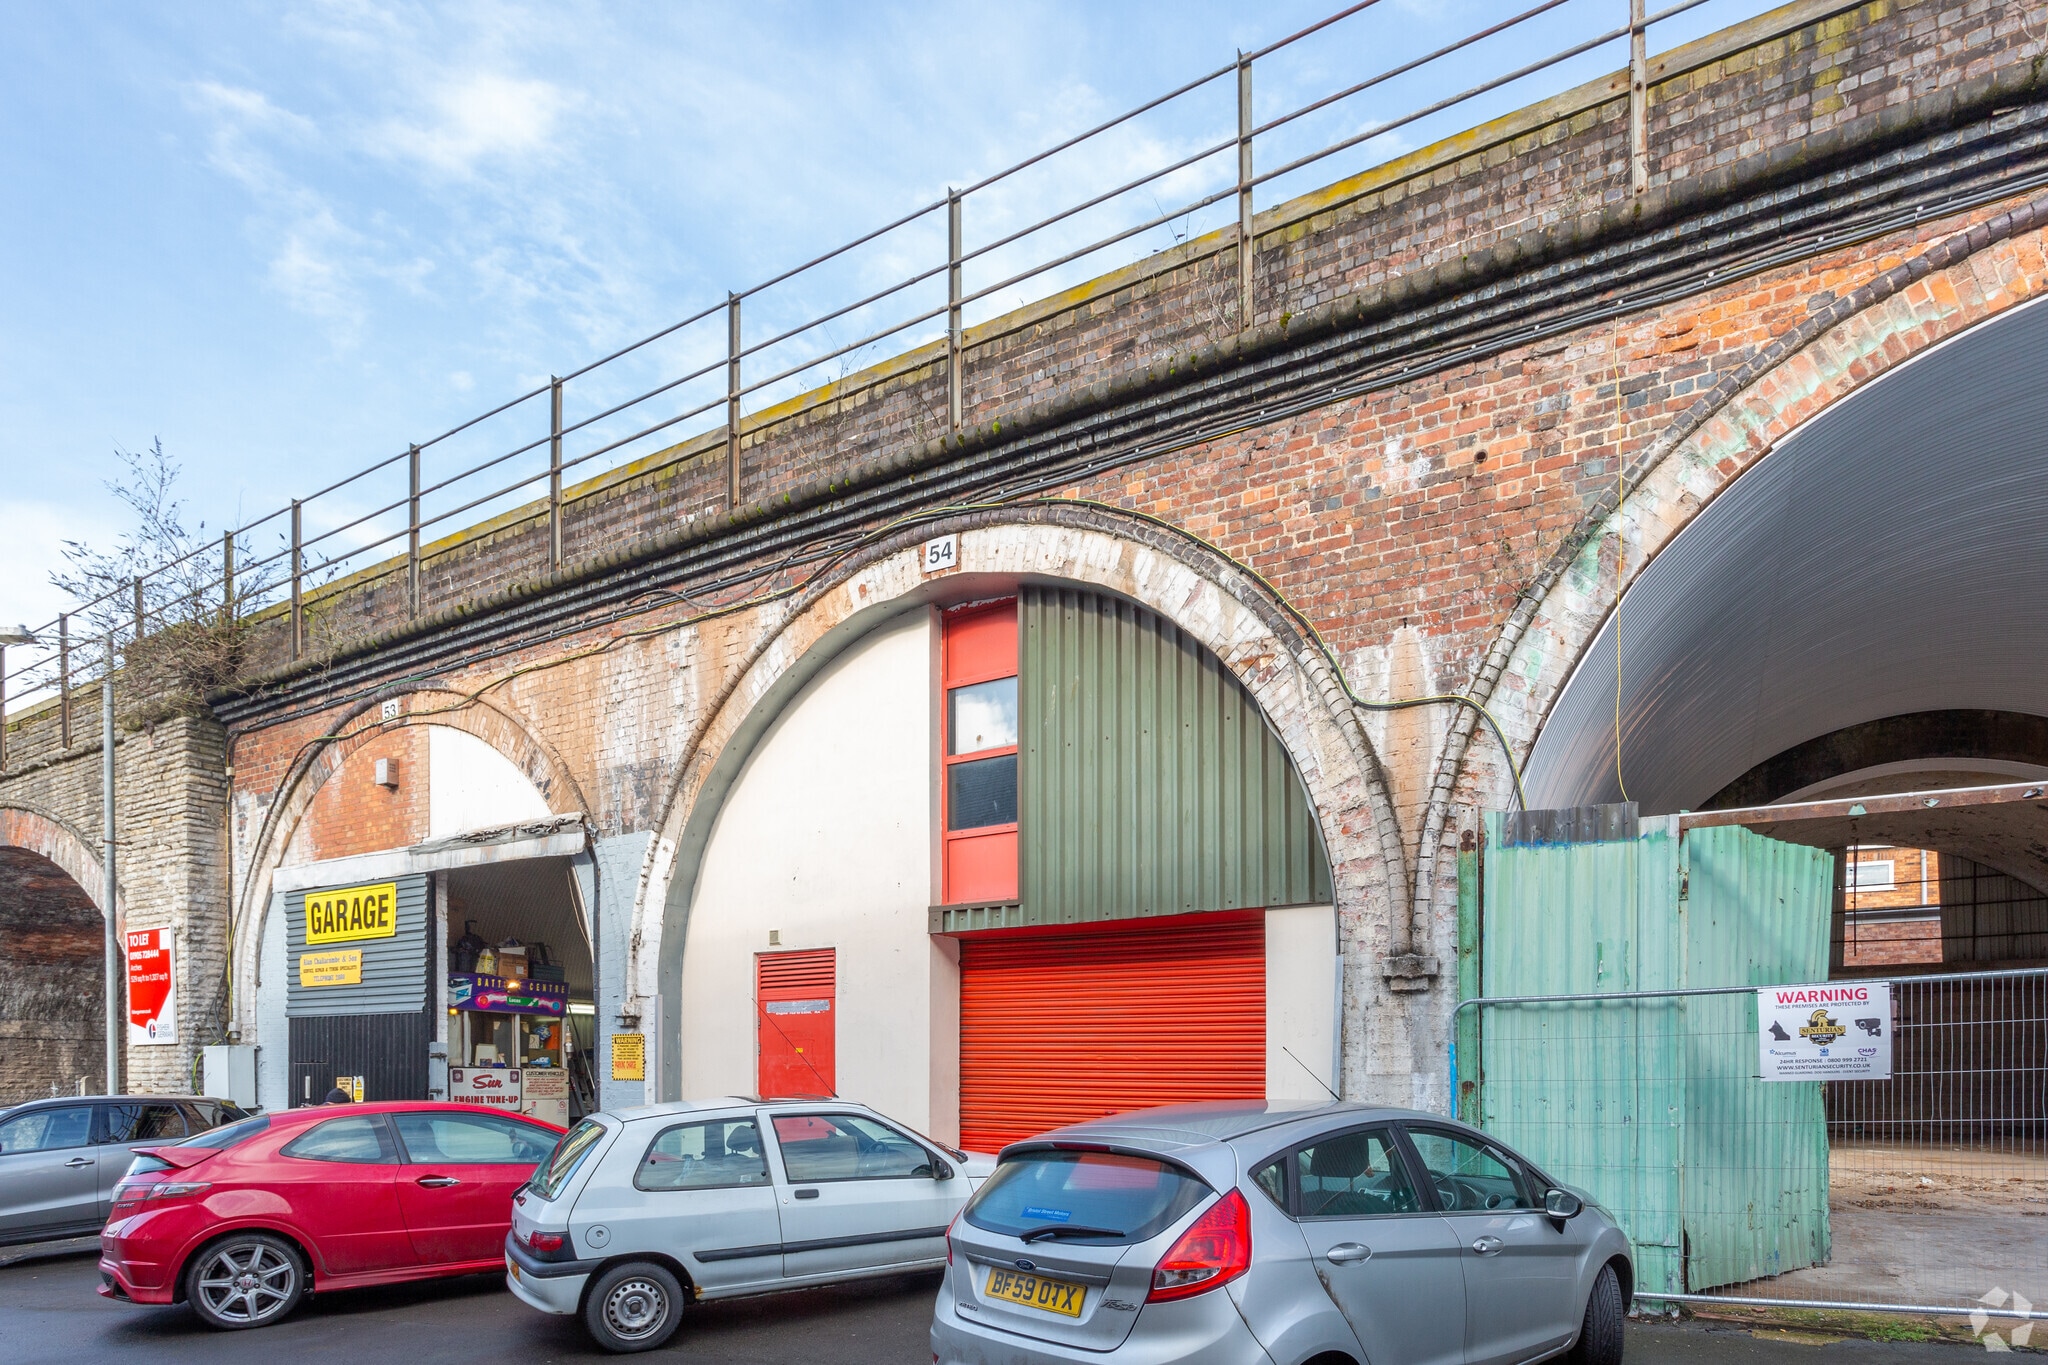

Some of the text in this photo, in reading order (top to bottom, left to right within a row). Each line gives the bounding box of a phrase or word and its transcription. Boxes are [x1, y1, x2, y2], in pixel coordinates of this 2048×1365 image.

[929, 541, 952, 564] 54
[384, 704, 396, 719] 53
[311, 894, 388, 934] GARAGE
[129, 933, 149, 947] TO LET
[530, 982, 565, 993] CENTRE
[1776, 988, 1868, 1004] WARNING
[472, 1074, 503, 1089] Sun
[1019, 1261, 1030, 1269] Ford
[992, 1272, 1077, 1310] BF59 OTX
[1101, 1299, 1137, 1311] Fiesta
